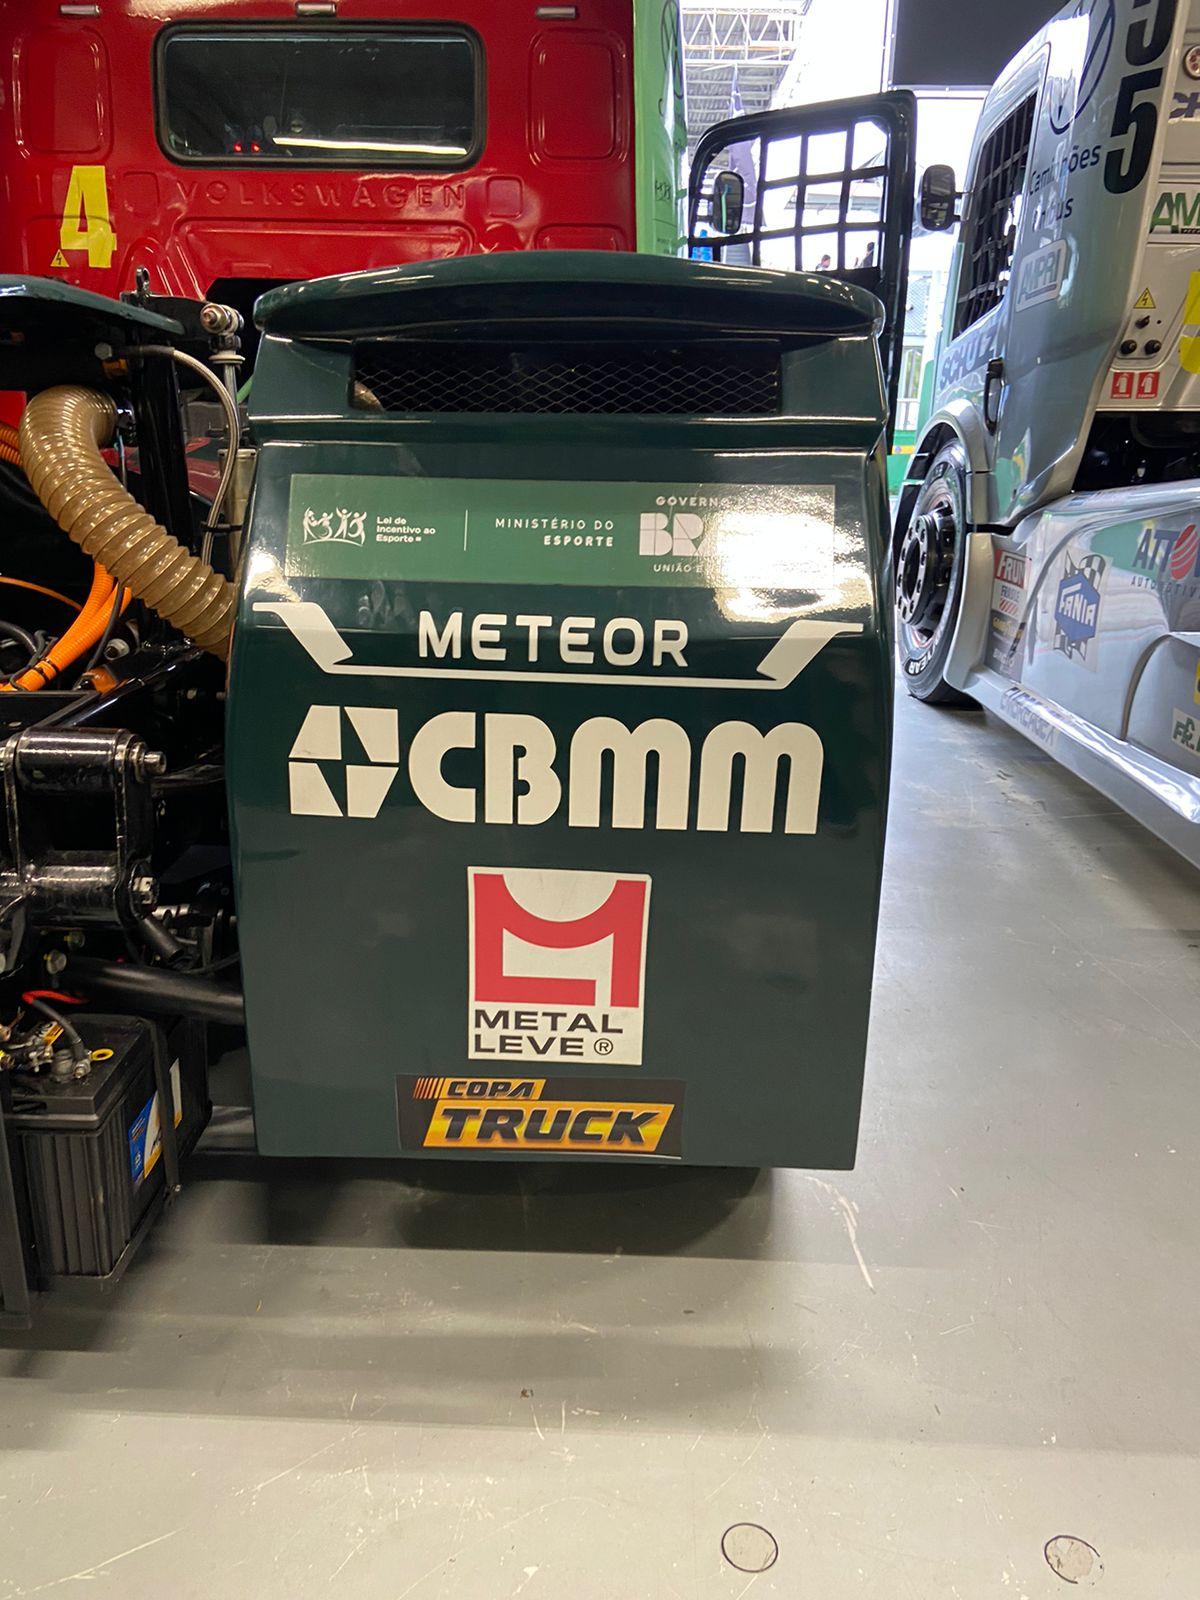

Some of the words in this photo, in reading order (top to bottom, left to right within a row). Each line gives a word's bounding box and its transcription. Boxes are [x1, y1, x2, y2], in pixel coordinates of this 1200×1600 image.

[176, 180, 466, 209] VOLKSWAGEN
[60, 165, 118, 269] 4
[376, 525, 421, 535] Incentivo
[423, 527, 436, 535] ao
[377, 516, 392, 525] Lei
[394, 516, 407, 525] de
[495, 517, 586, 530] MINISTÉRIO
[594, 520, 614, 530] DO
[375, 534, 414, 544] Esporte
[543, 535, 613, 547] ESPORTE
[1058, 582, 1097, 627] FANIA
[418, 610, 689, 667] METEOR
[475, 1009, 623, 1034] METAL
[447, 1080, 533, 1098] COPA
[442, 1108, 660, 1145] TRUCK
